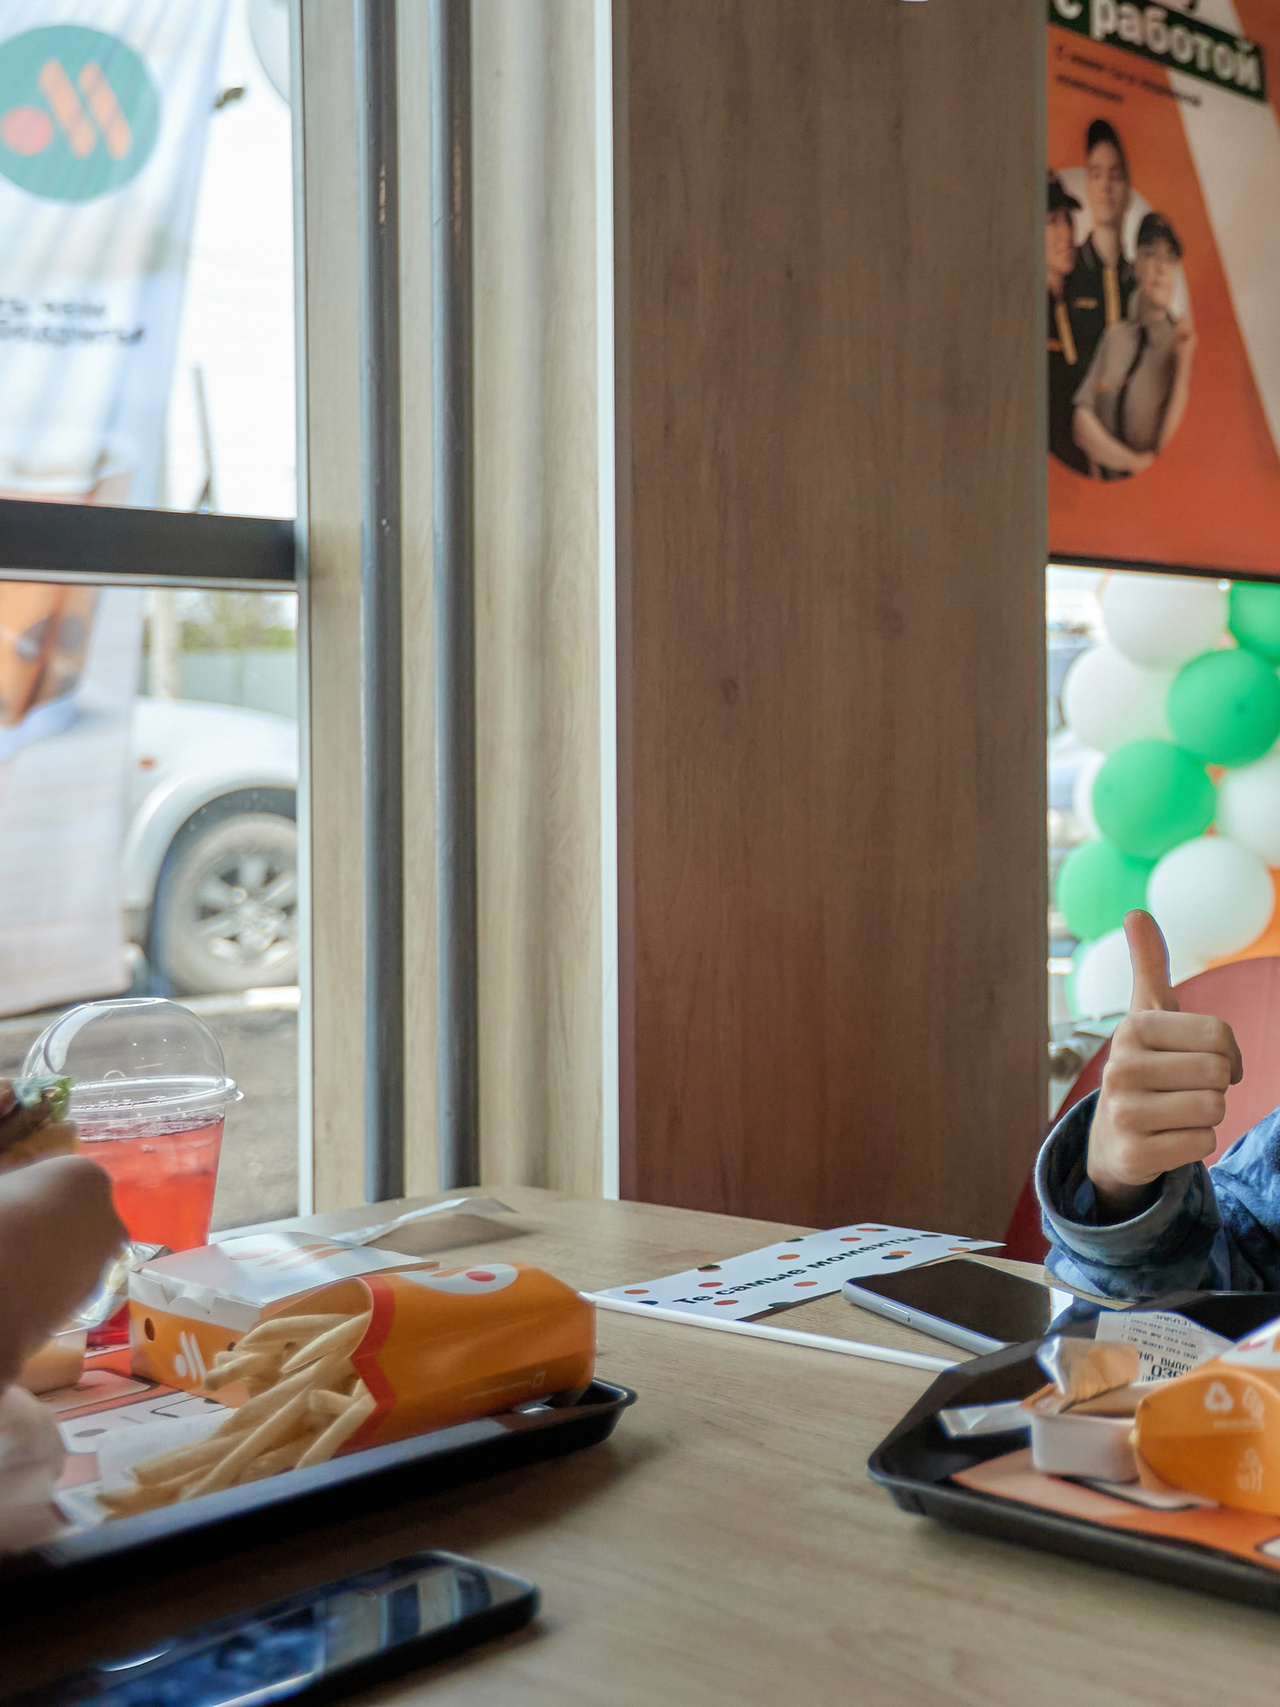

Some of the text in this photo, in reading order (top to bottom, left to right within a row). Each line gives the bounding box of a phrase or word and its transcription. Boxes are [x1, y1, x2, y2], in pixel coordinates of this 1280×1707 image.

[1089, 0, 1261, 91] работой
[672, 1235, 921, 1305] Те самые моменты
[1138, 1350, 1154, 1363] НА
